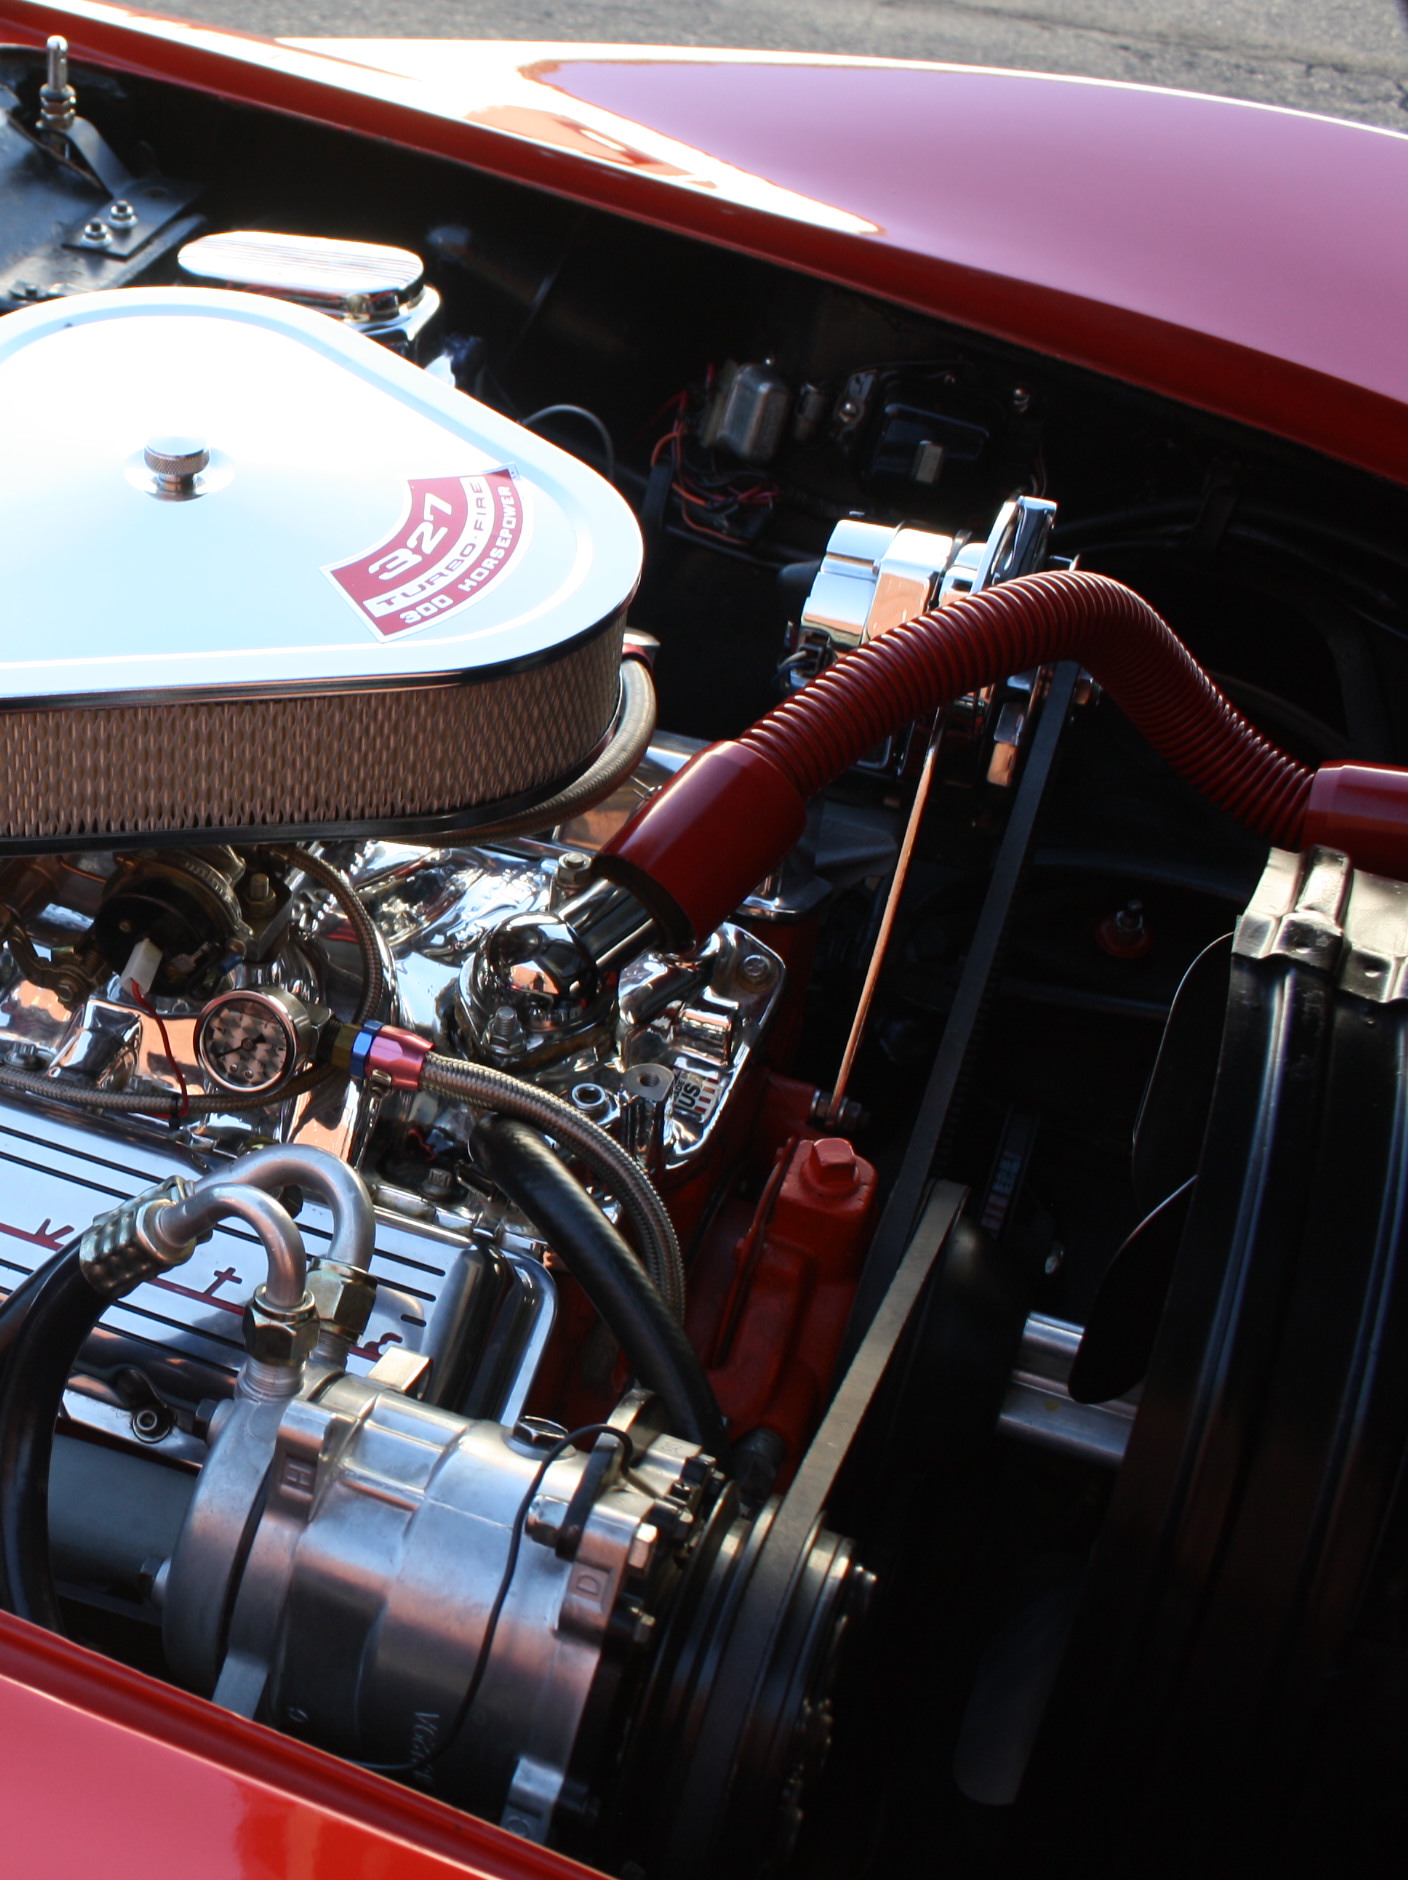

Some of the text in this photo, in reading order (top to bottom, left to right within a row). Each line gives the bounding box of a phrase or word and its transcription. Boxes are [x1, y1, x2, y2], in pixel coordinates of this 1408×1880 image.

[368, 492, 452, 581] 327
[399, 485, 517, 624] 300 HORSEPOWER
